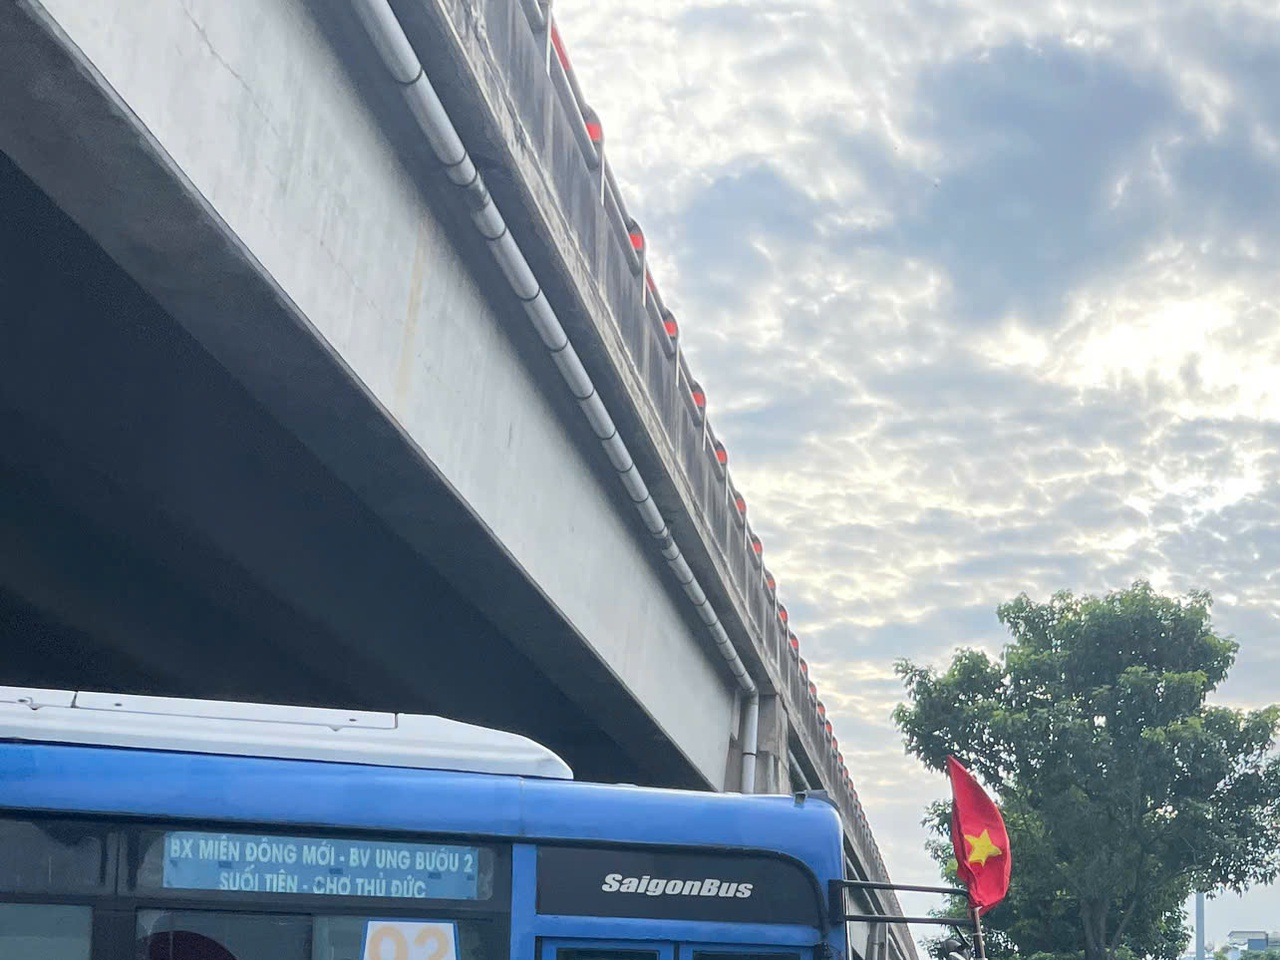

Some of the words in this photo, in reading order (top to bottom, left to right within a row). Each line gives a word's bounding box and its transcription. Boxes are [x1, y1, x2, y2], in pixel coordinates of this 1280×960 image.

[171, 838, 194, 859] BX
[245, 837, 297, 864] ĐÔNG
[303, 840, 335, 866] MỚI
[350, 847, 371, 868] BV
[376, 849, 410, 870] UNG
[416, 847, 459, 872] BƯỚU
[464, 853, 473, 873] 2
[219, 864, 259, 891] SUỐI
[264, 869, 298, 893] TIÊN
[356, 872, 386, 896] THỦ
[391, 874, 427, 898] ĐỨC
[602, 873, 753, 898] SaigonBus
